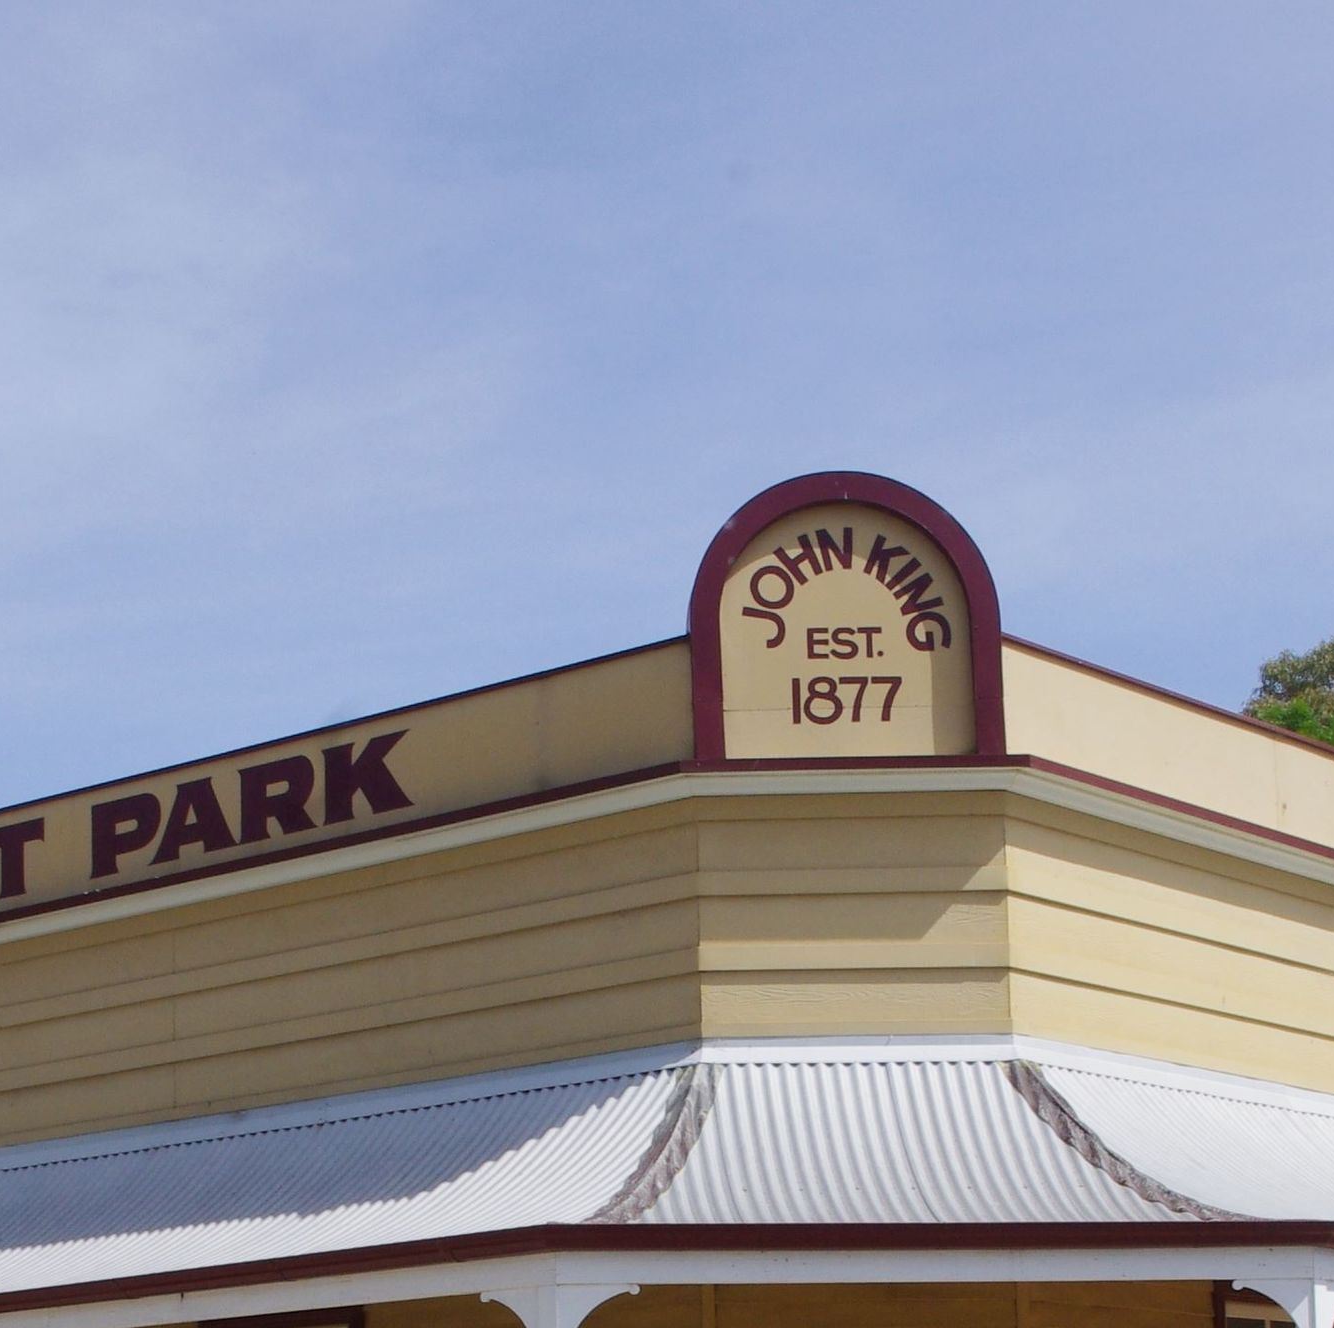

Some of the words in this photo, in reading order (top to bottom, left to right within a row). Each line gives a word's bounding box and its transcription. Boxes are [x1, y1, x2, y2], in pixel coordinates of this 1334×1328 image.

[742, 527, 853, 648] JOHN
[863, 534, 951, 652] KING
[806, 627, 884, 659] EST.
[791, 676, 902, 724] 1877
[90, 729, 414, 879] PARK
